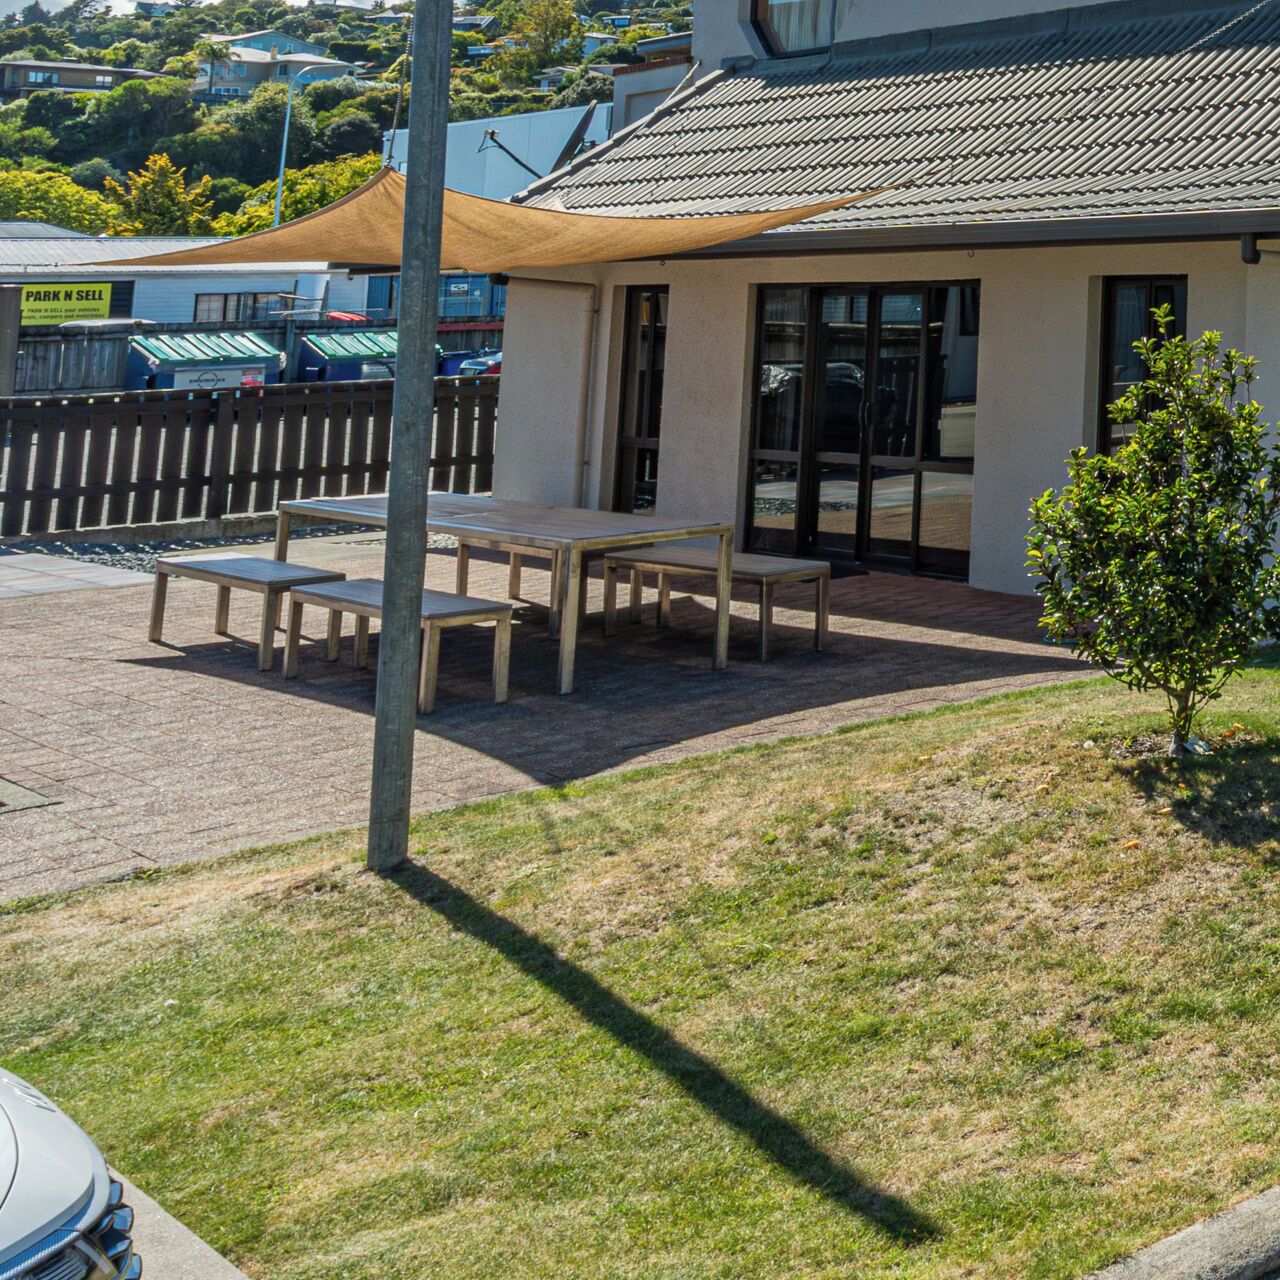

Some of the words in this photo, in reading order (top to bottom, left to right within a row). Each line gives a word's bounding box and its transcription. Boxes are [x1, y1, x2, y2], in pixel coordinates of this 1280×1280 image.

[25, 290, 61, 302] PARK
[63, 290, 73, 301] N
[76, 289, 104, 301] SELL
